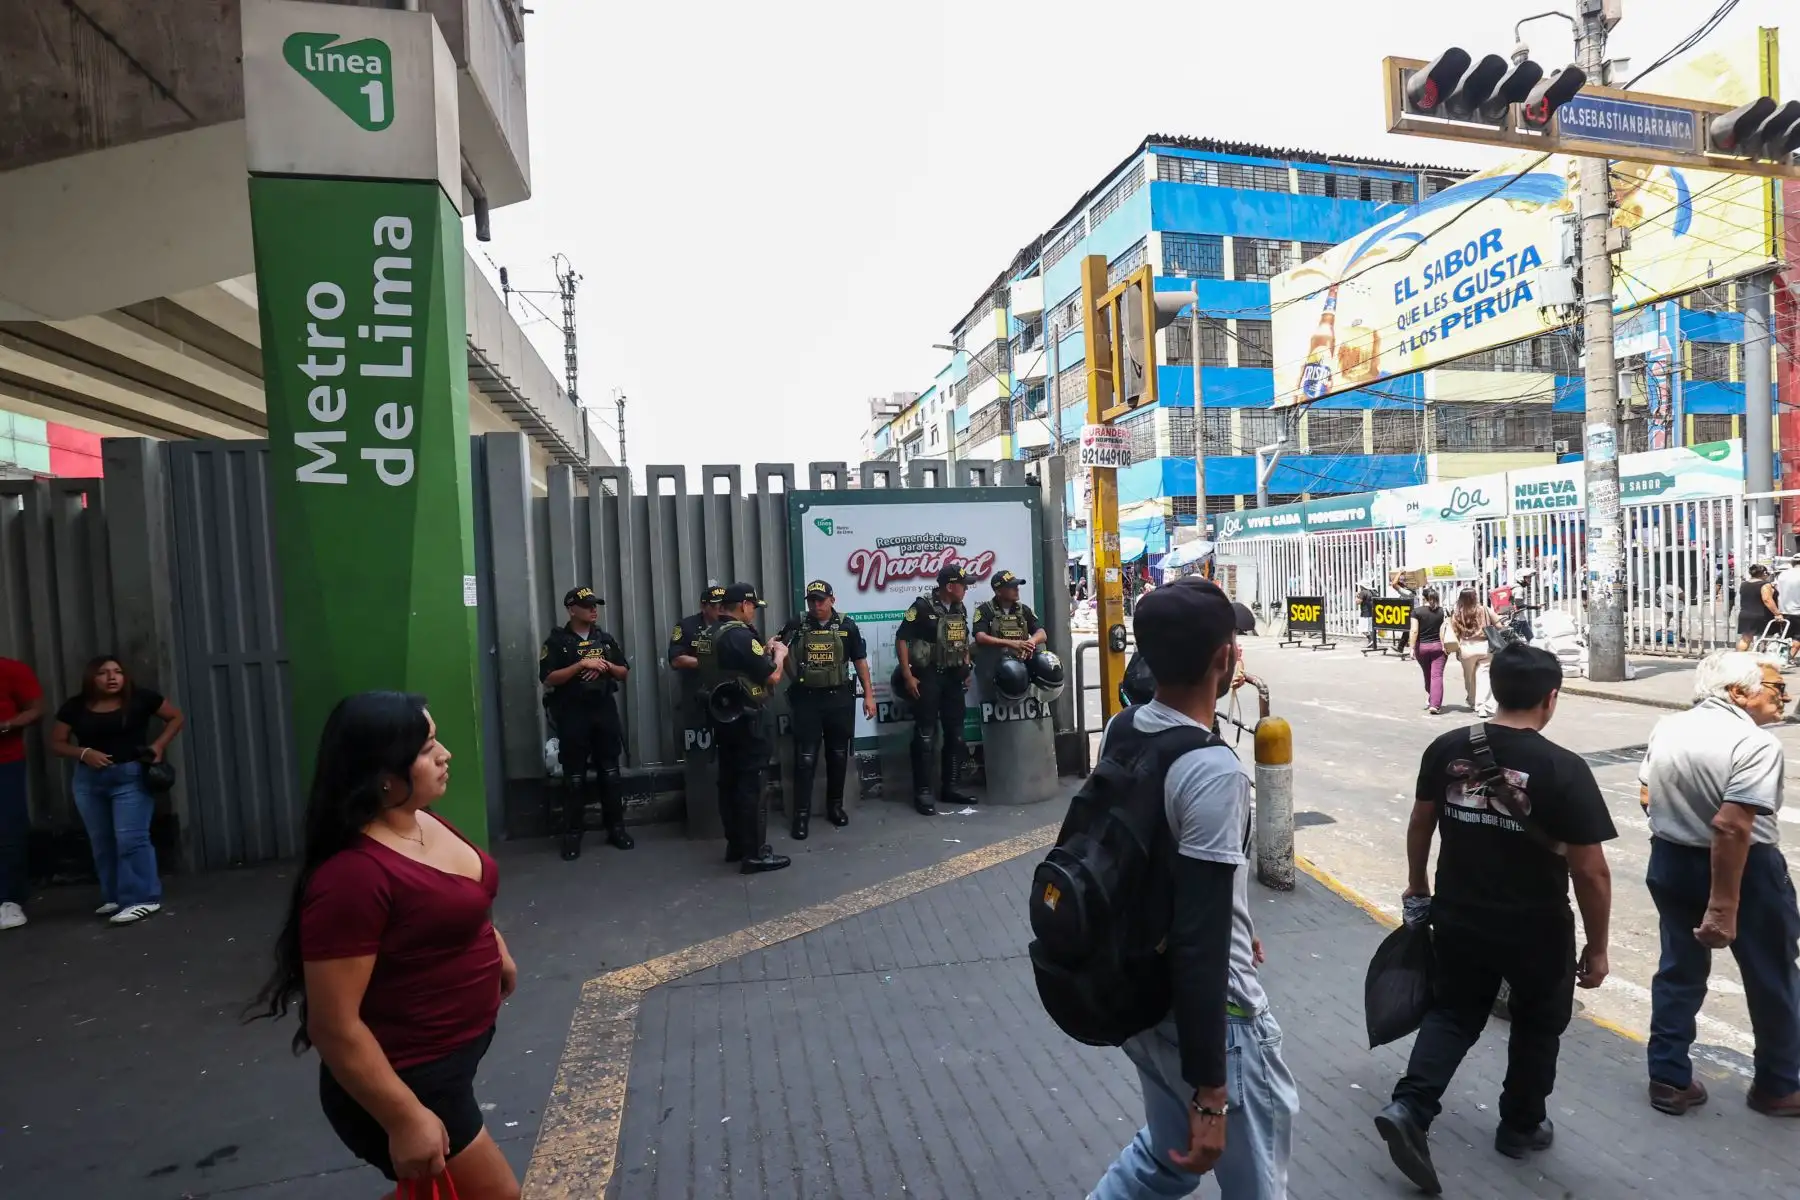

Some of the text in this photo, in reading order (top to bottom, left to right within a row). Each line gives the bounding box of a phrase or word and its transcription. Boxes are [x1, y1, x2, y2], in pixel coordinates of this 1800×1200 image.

[360, 80, 384, 122] 1
[1394, 228, 1504, 305] EL SABOR
[1397, 244, 1543, 331] QUE LES GUSTA
[358, 215, 414, 486] de Lima
[1399, 340, 1407, 356] A
[1410, 325, 1437, 351] LOS
[295, 281, 348, 485] Metro
[1082, 448, 1131, 466] 921449108
[1515, 479, 1577, 497] NUEVA
[1629, 479, 1661, 492] SABOR
[1440, 486, 1490, 518] Loa
[1515, 494, 1578, 510] IMAGEN
[1218, 516, 1244, 538] Loa
[1247, 516, 1270, 528] VIVE
[1272, 512, 1301, 526] CADA
[1308, 507, 1366, 525] MOMENTO
[877, 533, 966, 548] Recomendaciones
[901, 542, 944, 555] para esta
[1290, 604, 1321, 622] SGOF
[1375, 604, 1410, 625] SGOF
